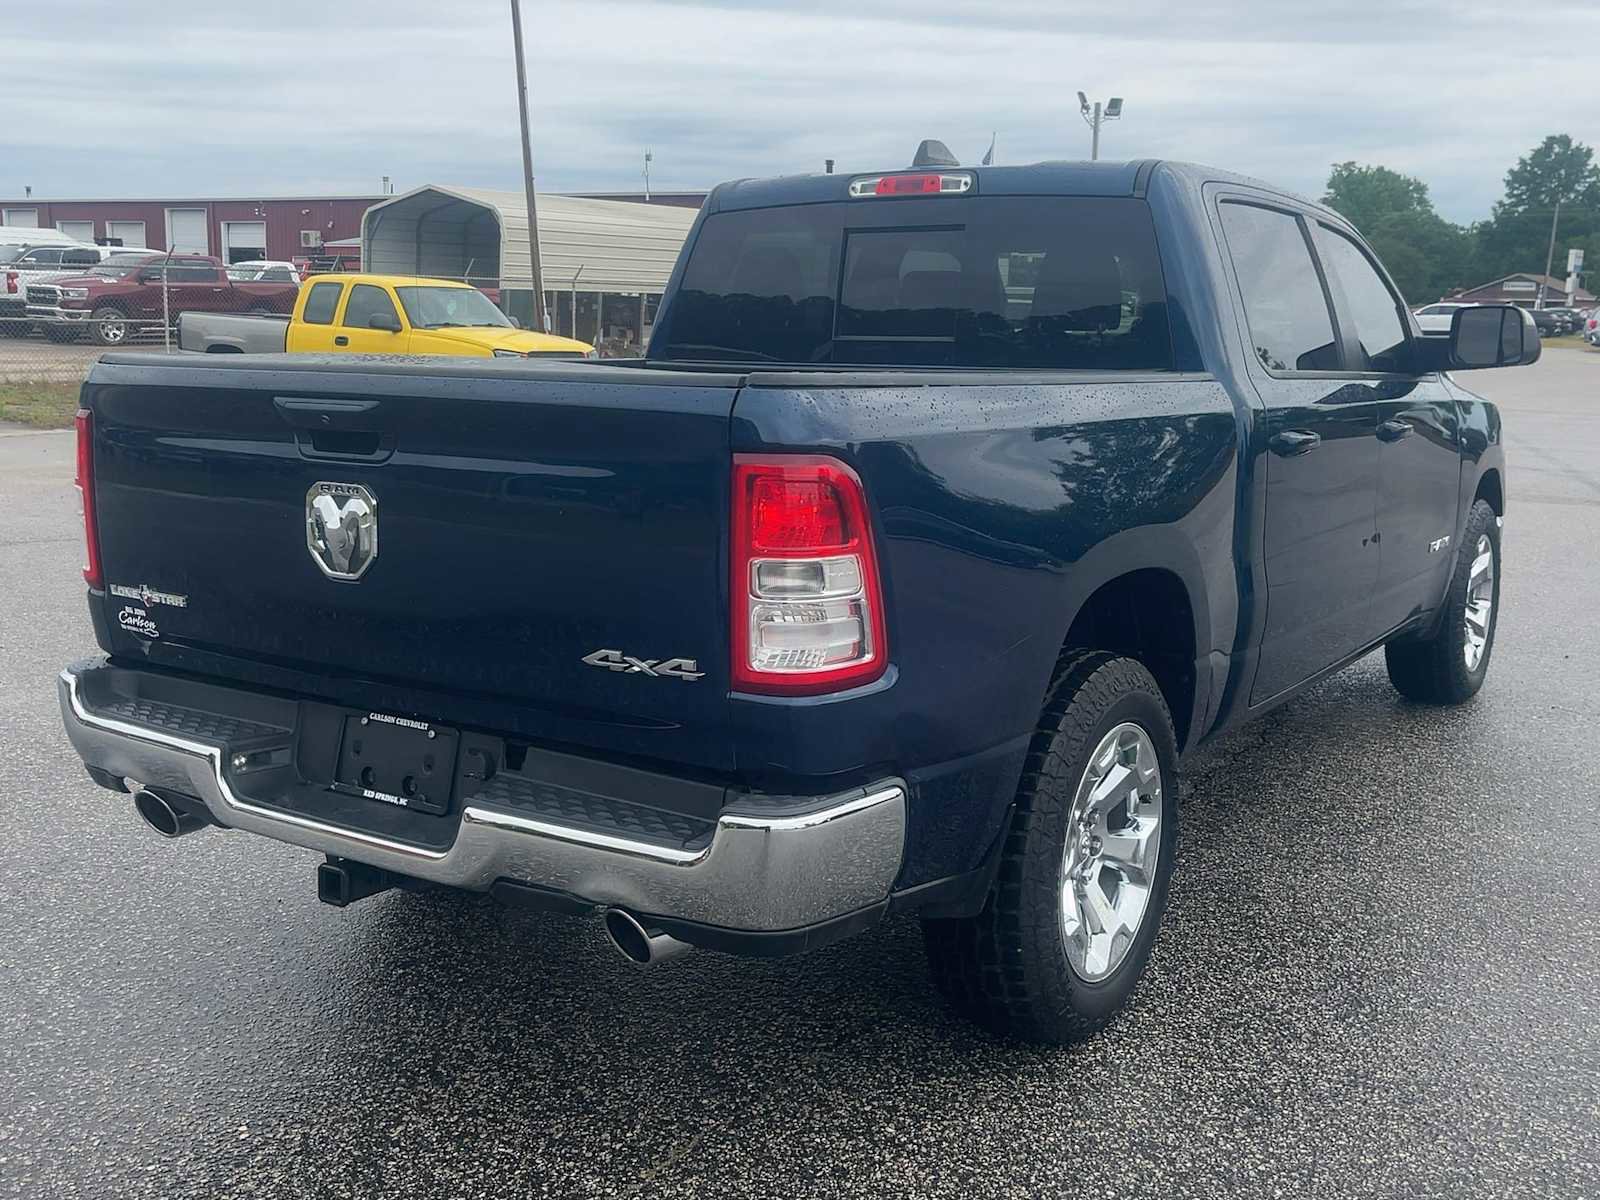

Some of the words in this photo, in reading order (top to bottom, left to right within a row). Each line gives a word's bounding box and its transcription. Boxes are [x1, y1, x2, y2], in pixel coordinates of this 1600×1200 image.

[320, 484, 360, 497] RAM
[109, 584, 141, 599] LONE
[152, 592, 188, 607] STAR
[118, 611, 156, 629] Carlson
[369, 712, 396, 723] CARLSON
[396, 717, 428, 730] CHEVROLET
[363, 789, 375, 799] RED
